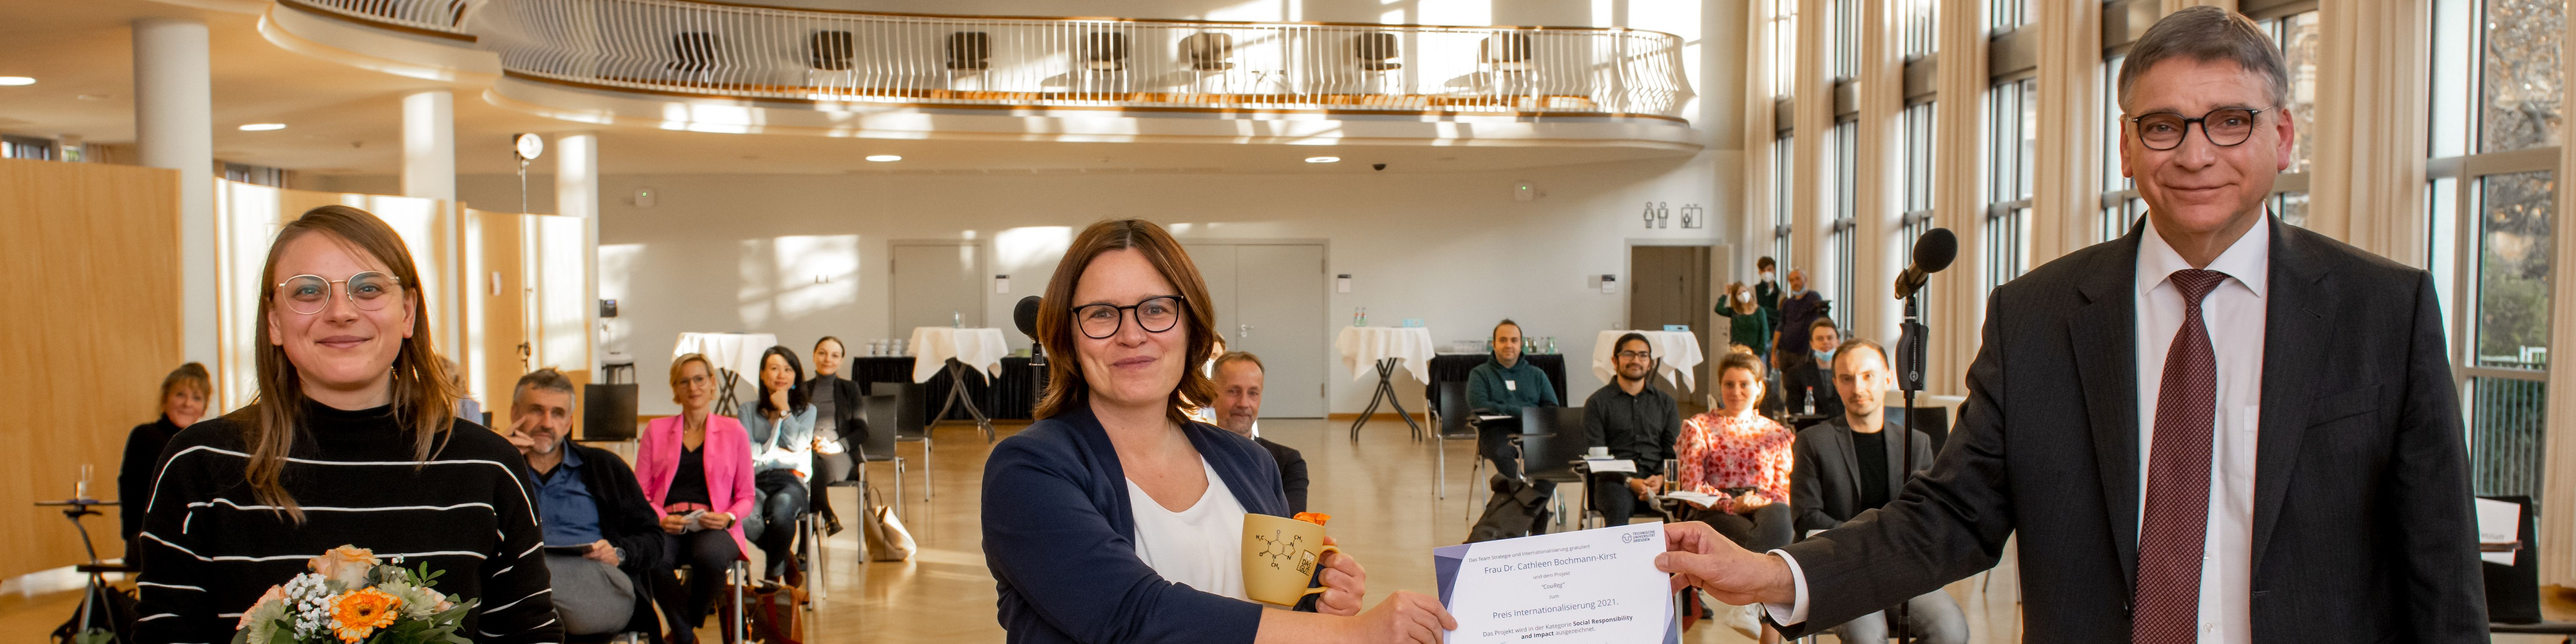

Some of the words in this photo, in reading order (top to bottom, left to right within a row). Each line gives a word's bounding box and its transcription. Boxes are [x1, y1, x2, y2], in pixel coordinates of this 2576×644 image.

[1305, 552, 1314, 561] TUD
[1522, 547, 1568, 556] Internationalisierung
[1302, 559, 1311, 568] DAS
[1518, 560, 1552, 570] Cathleen
[1554, 552, 1617, 566] Bochmann-Kirst
[1493, 611, 1512, 619] Preis
[1514, 602, 1596, 616] Internationalisierung
[1597, 598, 1619, 607] 2021.
[1546, 622, 1572, 630] Kategorie
[1592, 615, 1633, 625] Responsibility
